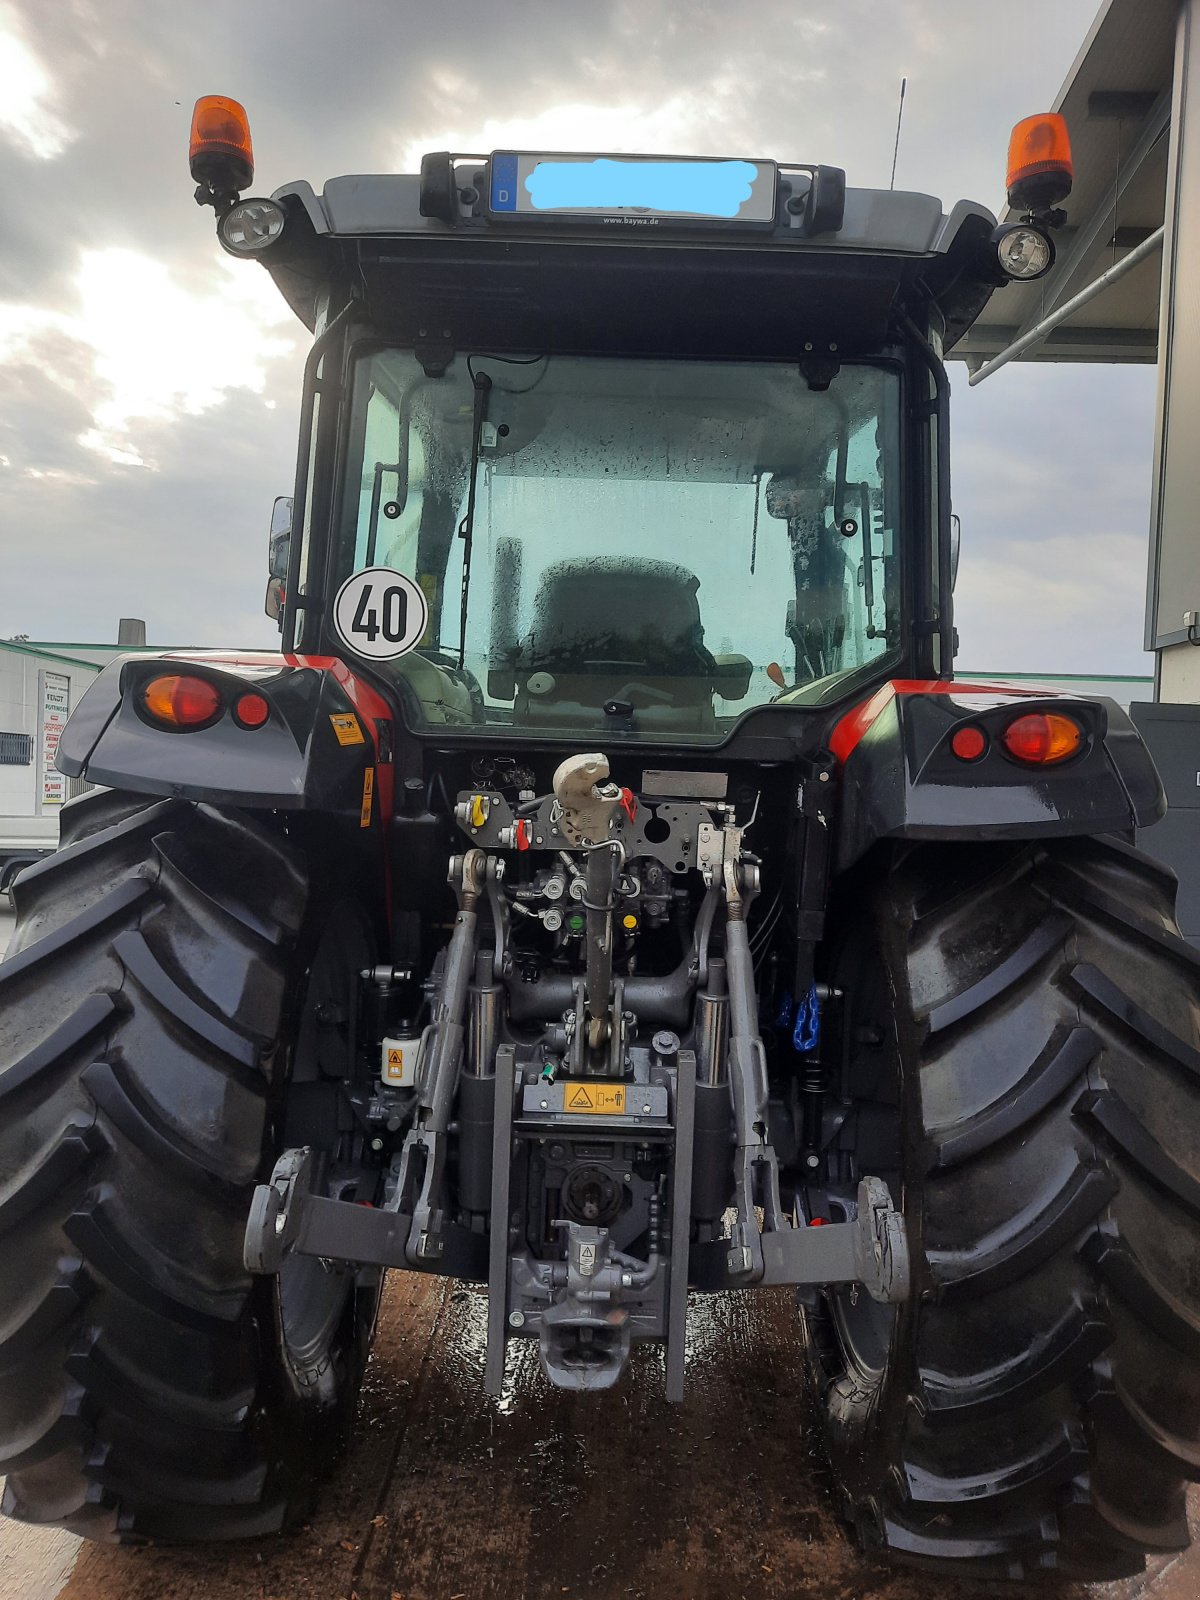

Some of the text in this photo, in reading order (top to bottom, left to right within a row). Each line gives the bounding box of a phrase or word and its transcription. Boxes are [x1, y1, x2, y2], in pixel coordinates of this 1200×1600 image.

[500, 190, 509, 202] D
[603, 217, 659, 225] www.baywa.de
[352, 585, 407, 642] 40
